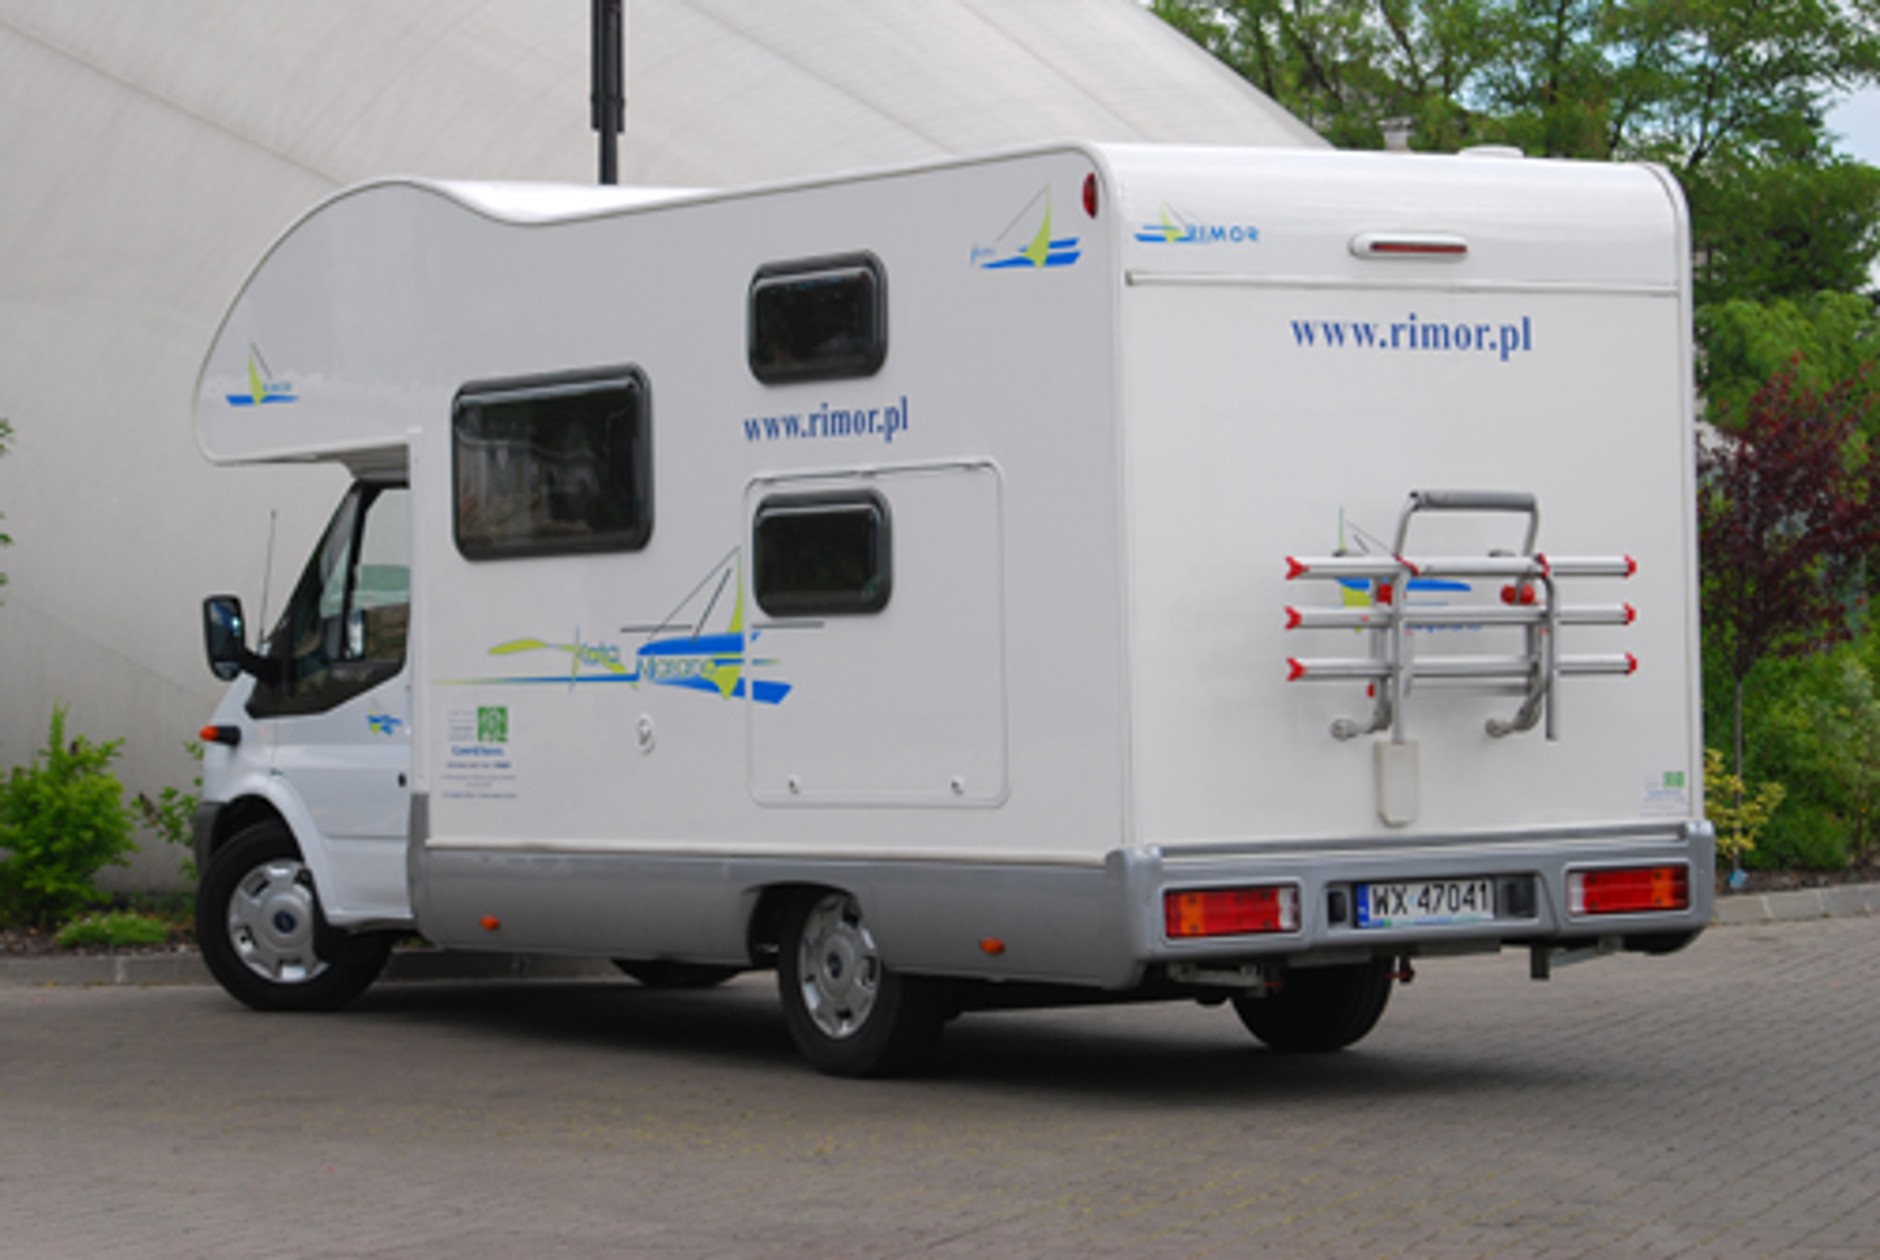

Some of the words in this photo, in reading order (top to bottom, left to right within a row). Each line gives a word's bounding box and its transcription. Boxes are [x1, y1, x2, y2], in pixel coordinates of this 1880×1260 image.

[1291, 312, 1531, 361] www.rimor.pl
[744, 395, 908, 443] www.rimor.pl
[1373, 885, 1407, 915] WX
[1417, 881, 1488, 914] 47041
